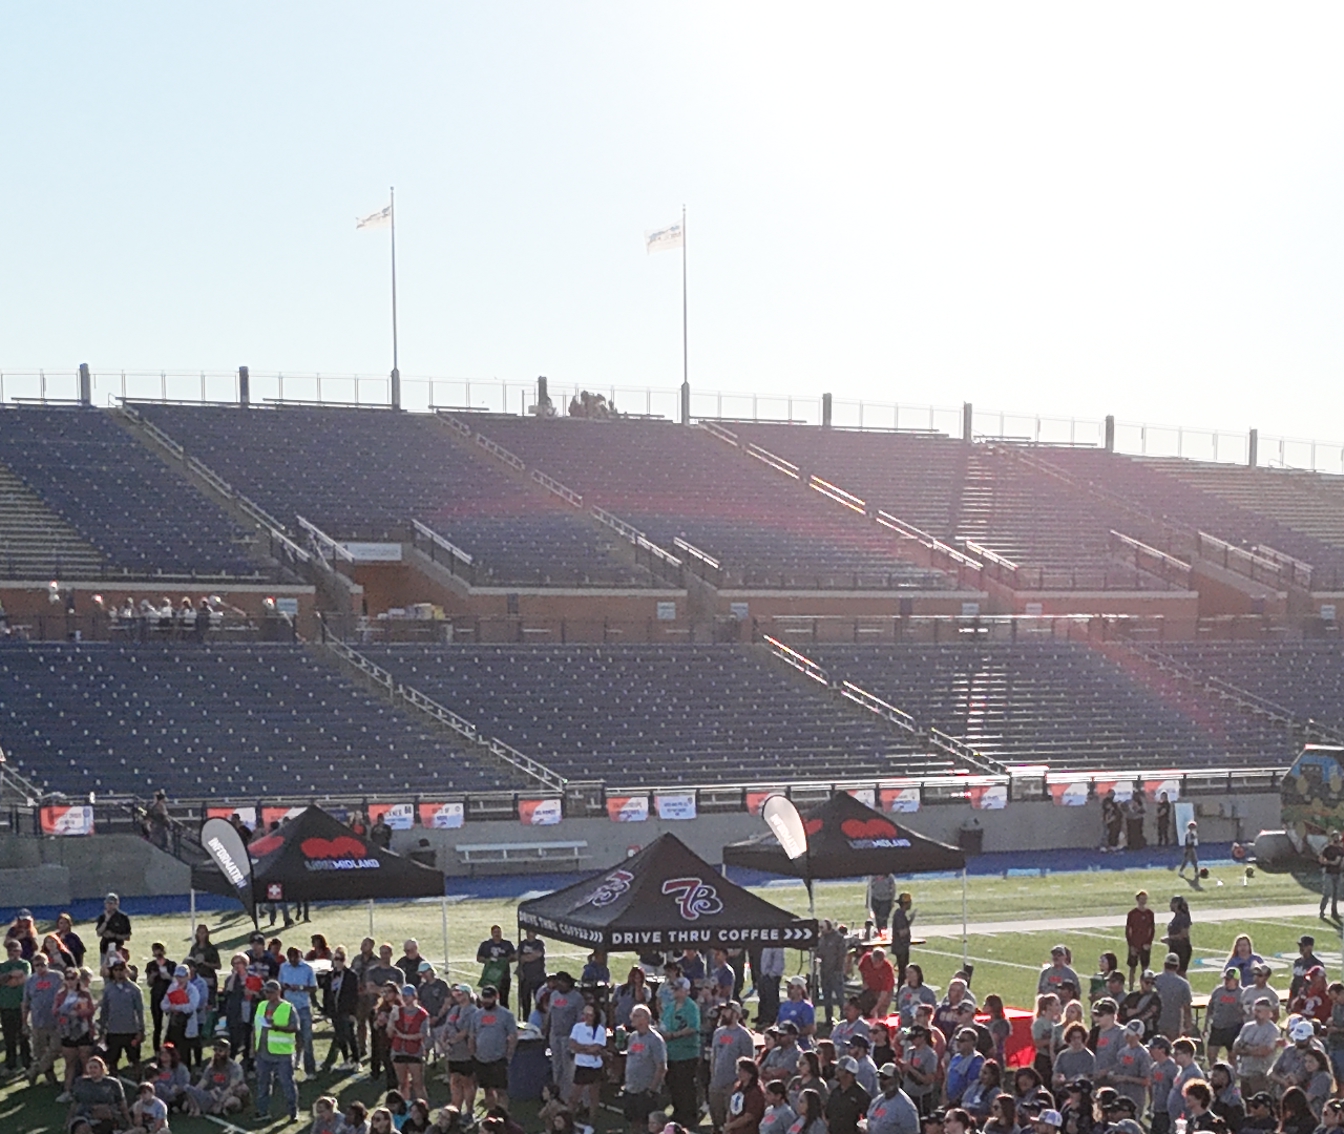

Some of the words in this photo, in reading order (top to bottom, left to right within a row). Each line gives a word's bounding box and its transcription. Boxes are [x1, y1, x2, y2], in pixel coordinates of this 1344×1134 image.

[207, 837, 248, 888] INFORMATION
[612, 931, 662, 944] DRIVE
[668, 929, 711, 942] THRU
[718, 928, 779, 941] COFFEE
